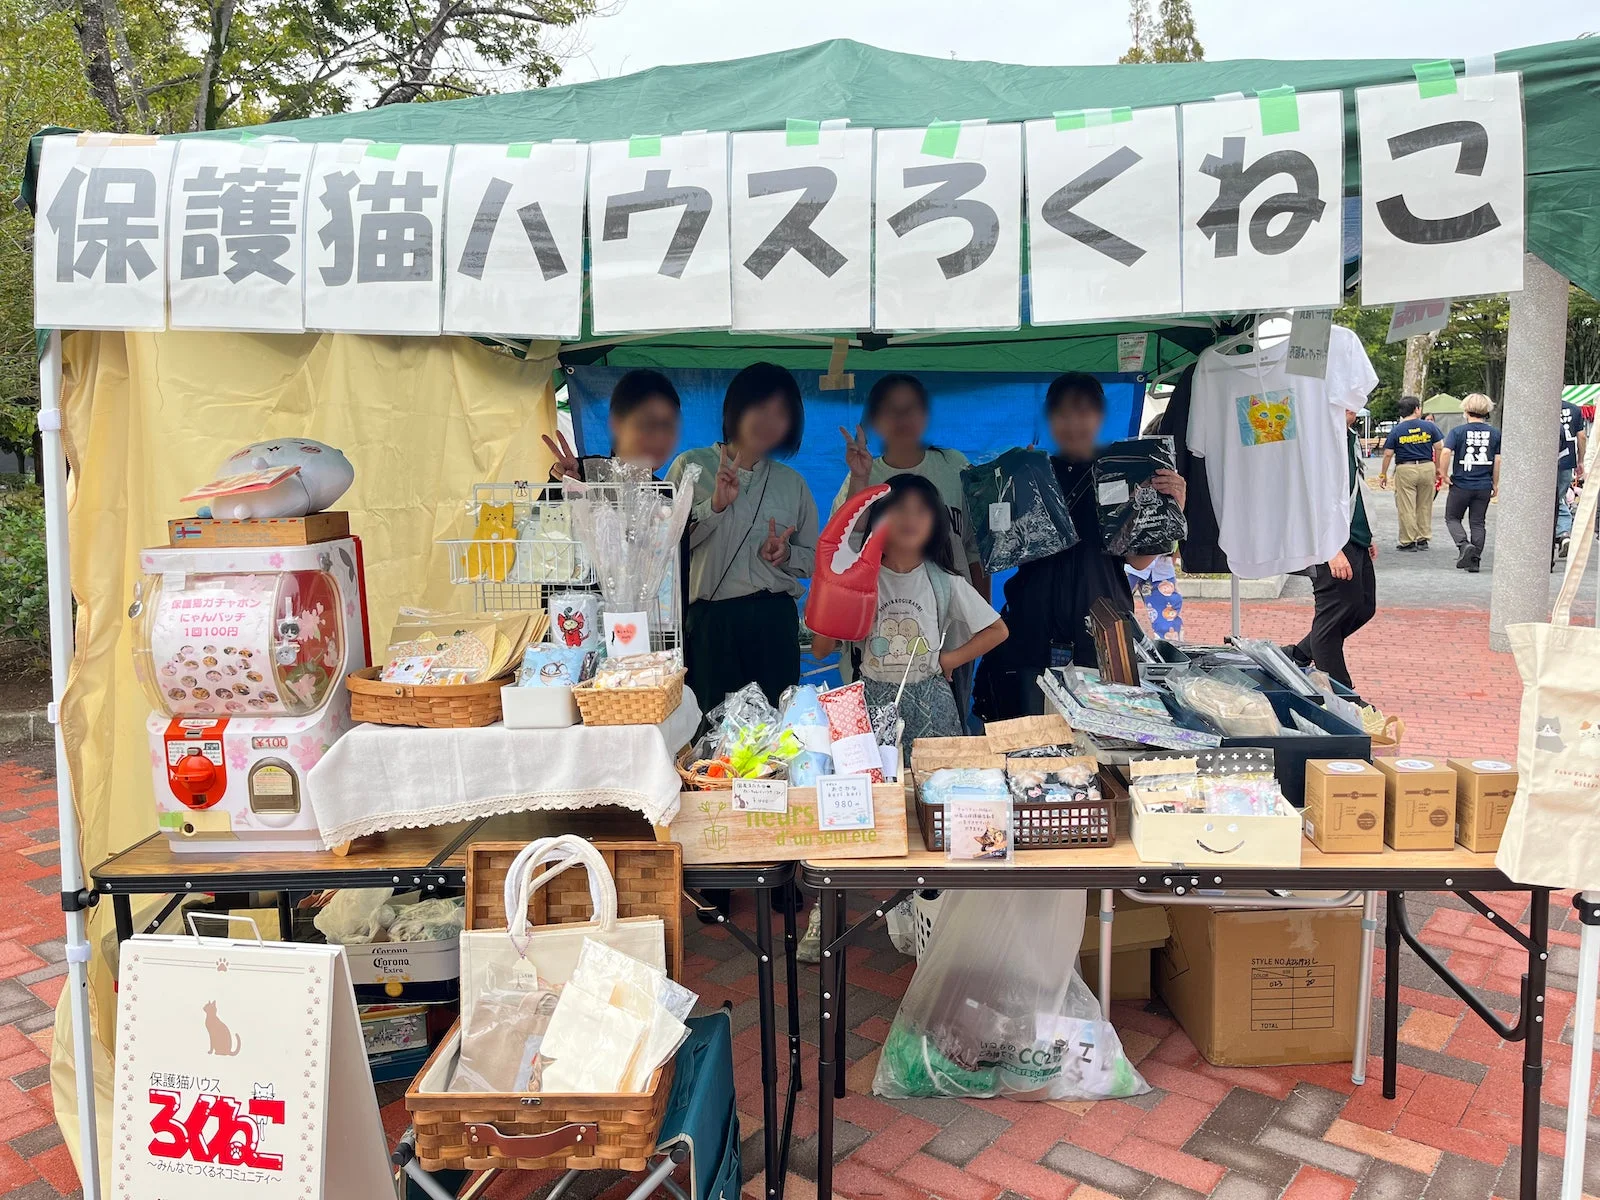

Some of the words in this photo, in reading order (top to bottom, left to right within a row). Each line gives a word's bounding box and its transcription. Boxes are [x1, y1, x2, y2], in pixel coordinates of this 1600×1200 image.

[47, 120, 1502, 284] 保護猫ハウスろくねこ
[184, 627, 238, 637] 1回100円
[256, 737, 288, 748] ¥100
[373, 957, 410, 968] Corona
[980, 1041, 1016, 1052] いつもの
[149, 1072, 221, 1093] 保護猫ハウス
[148, 1088, 285, 1171] ろくねこ
